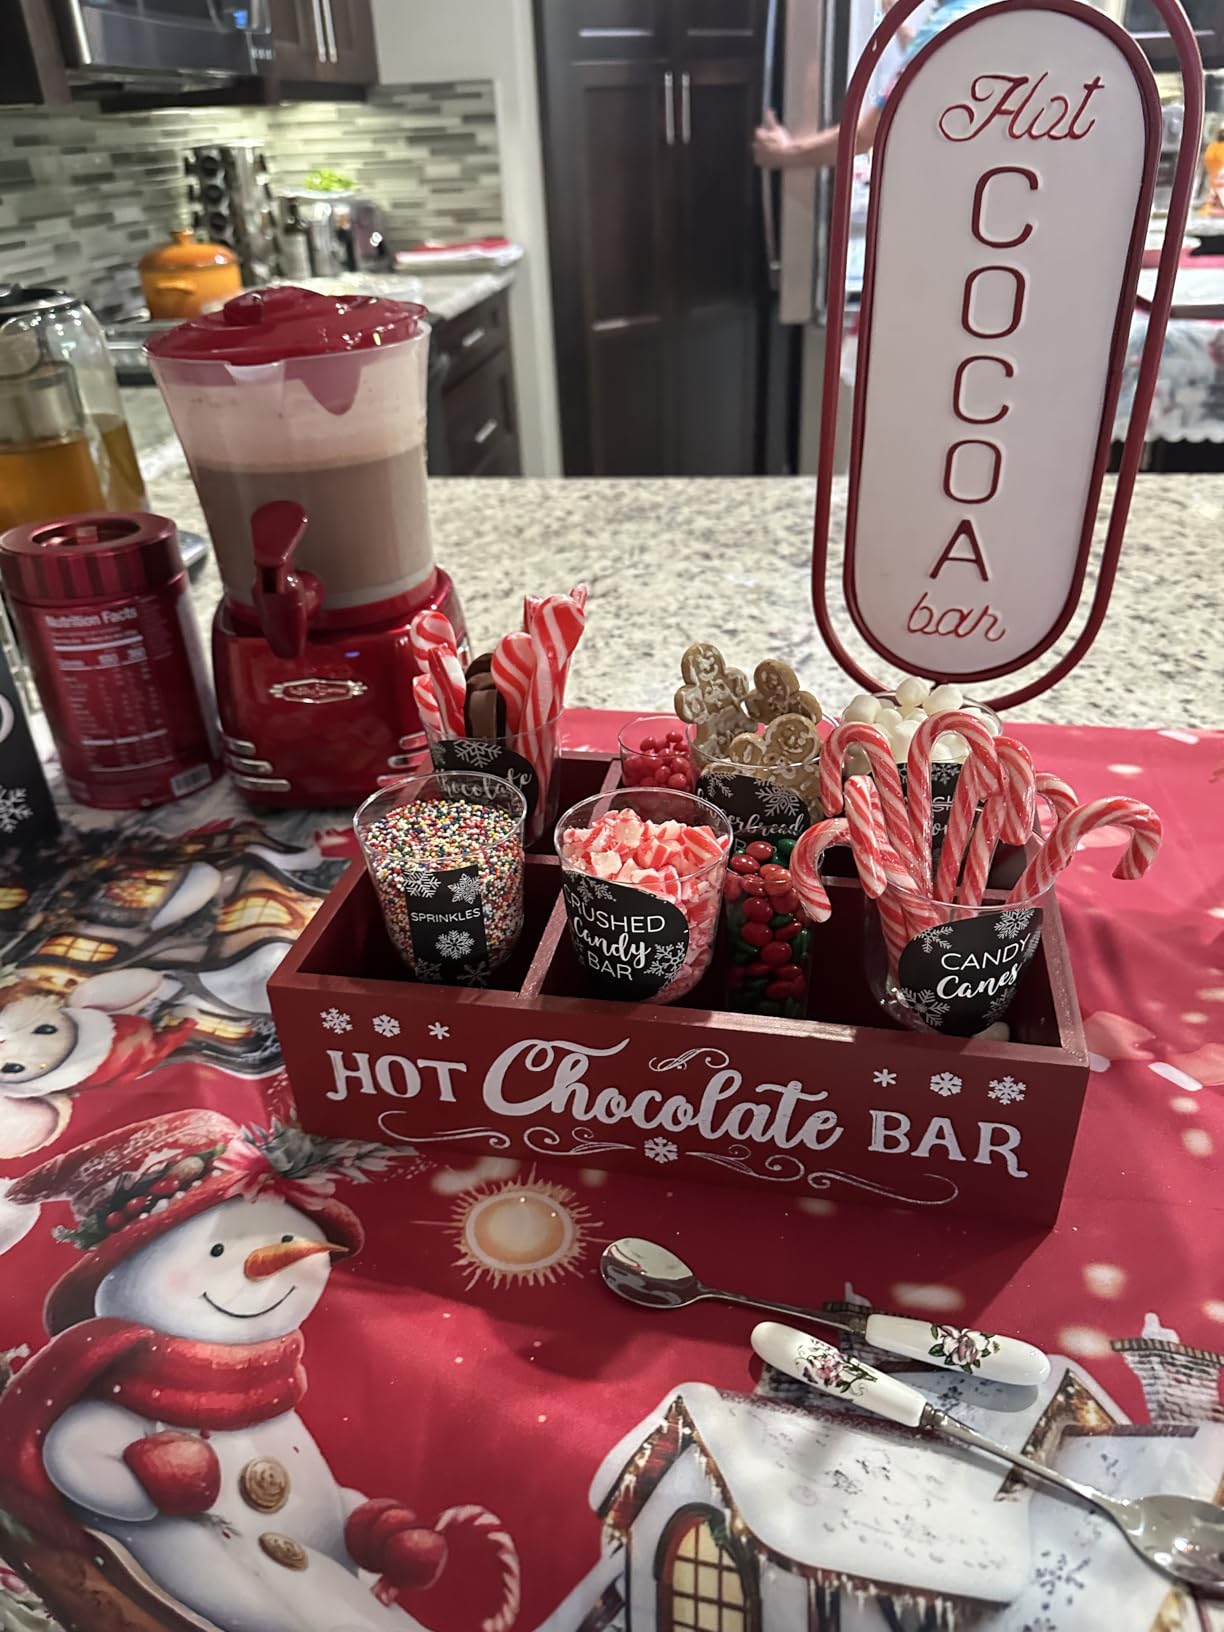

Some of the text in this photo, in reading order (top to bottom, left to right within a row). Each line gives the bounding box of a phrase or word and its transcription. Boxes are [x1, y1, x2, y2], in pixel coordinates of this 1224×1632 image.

[938, 71, 1106, 142] Hot
[928, 165, 1040, 583] COCOA
[906, 591, 1006, 642] bar
[410, 907, 482, 924] SPRINKLES
[573, 915, 652, 969] Candy
[587, 950, 633, 981] BAR
[940, 932, 1032, 972] CANDY
[936, 961, 1023, 1000] Canes
[325, 1037, 1029, 1179] HOT Chocolate BAR
